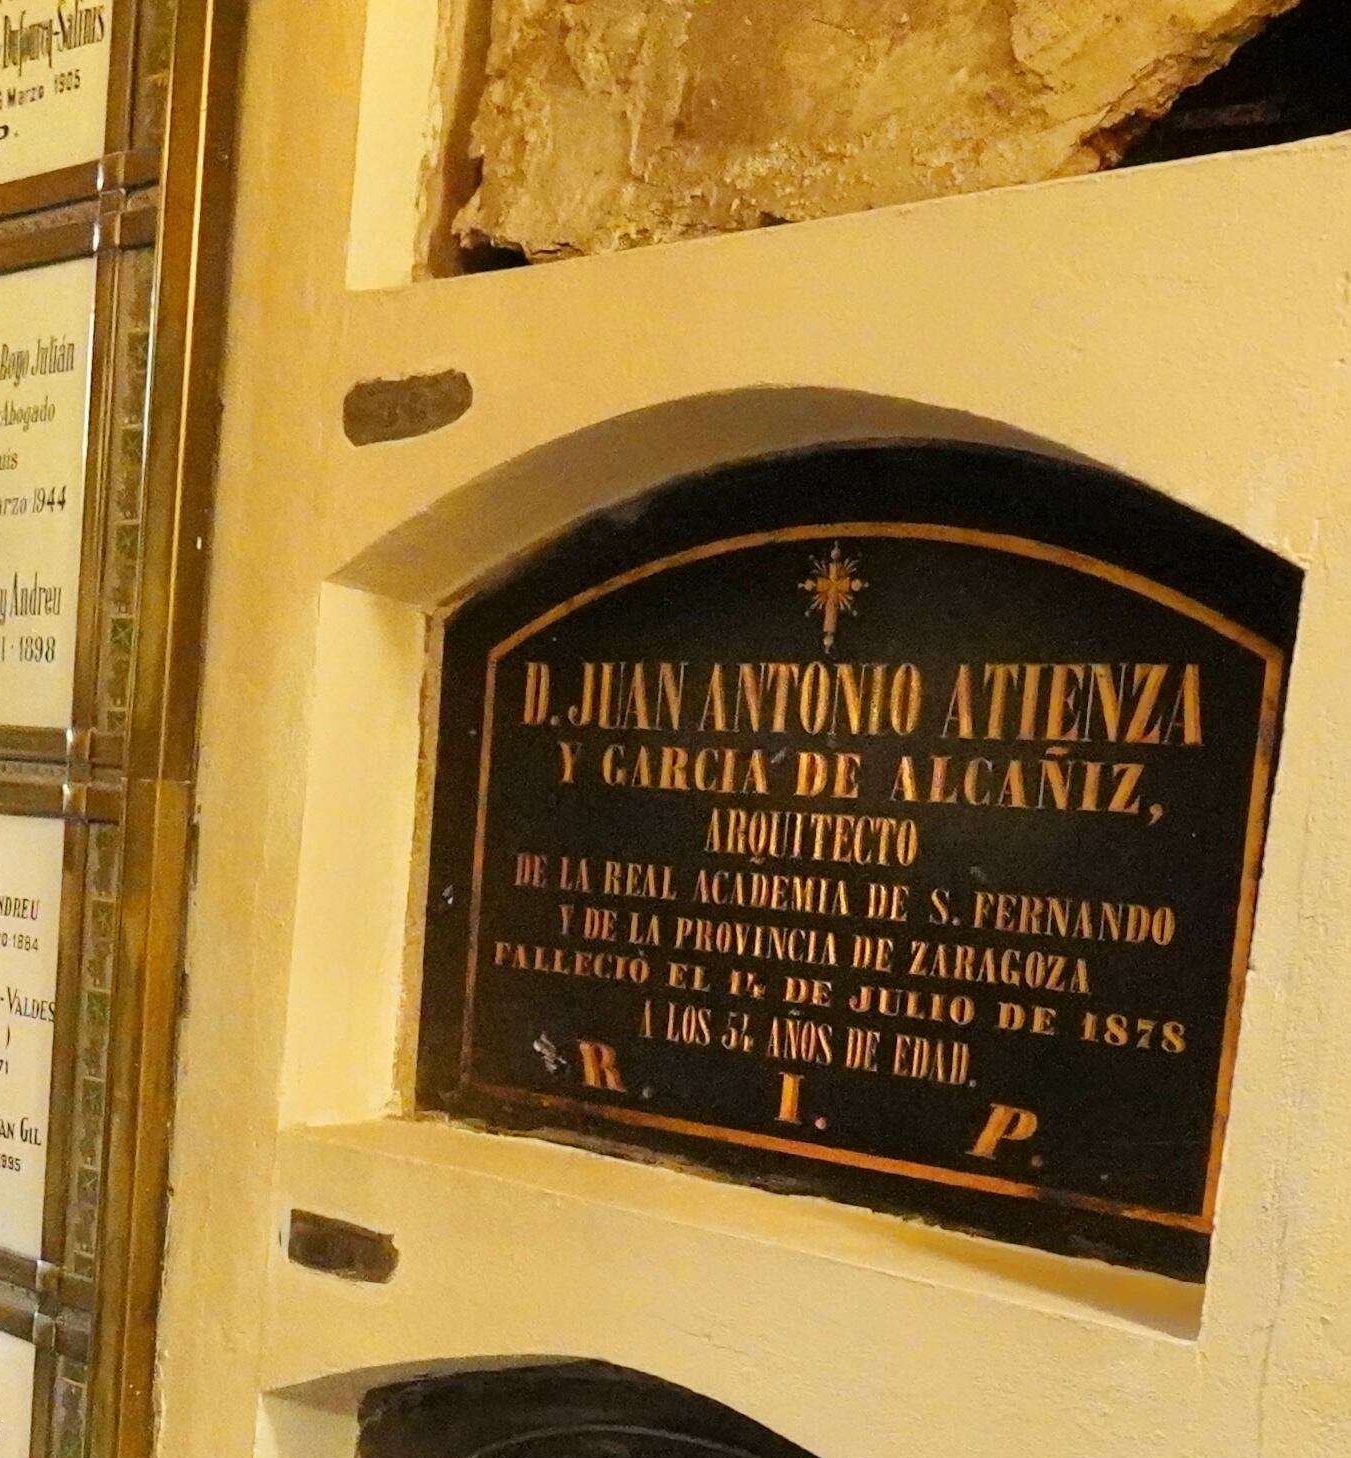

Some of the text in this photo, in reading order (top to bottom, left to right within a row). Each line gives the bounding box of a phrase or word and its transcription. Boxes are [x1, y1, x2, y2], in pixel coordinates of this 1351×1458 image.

[7, 85, 44, 107] Marzo
[31, 335, 75, 377] Julián
[32, 485, 67, 514] 1944
[10, 571, 62, 617] Andreu
[19, 635, 57, 663] 1898
[521, 660, 1205, 747] D. JUAN ANTONIO ATIENZA
[559, 741, 583, 784] Y
[793, 750, 860, 800] DE
[890, 745, 1165, 827] ALCAÑIZ,
[703, 807, 919, 868] ARQUITECTO
[513, 853, 1176, 947] DE LA REAL ACADEMIA DE S. FERNANDO
[559, 903, 1092, 996] Y DE LA PROVINCIA DE ZARAGOZA
[667, 961, 711, 993] EL
[783, 975, 833, 1008] DE
[850, 985, 976, 1026] JULIO
[997, 1001, 1057, 1036] DE
[1080, 1011, 1187, 1054] 1878
[640, 1000, 654, 1039] A
[666, 1001, 713, 1047] LOS
[767, 1008, 834, 1067] AÑOS
[845, 1026, 881, 1073] DE
[892, 1033, 977, 1088] EDAD.
[20, 1116, 42, 1147] GIL
